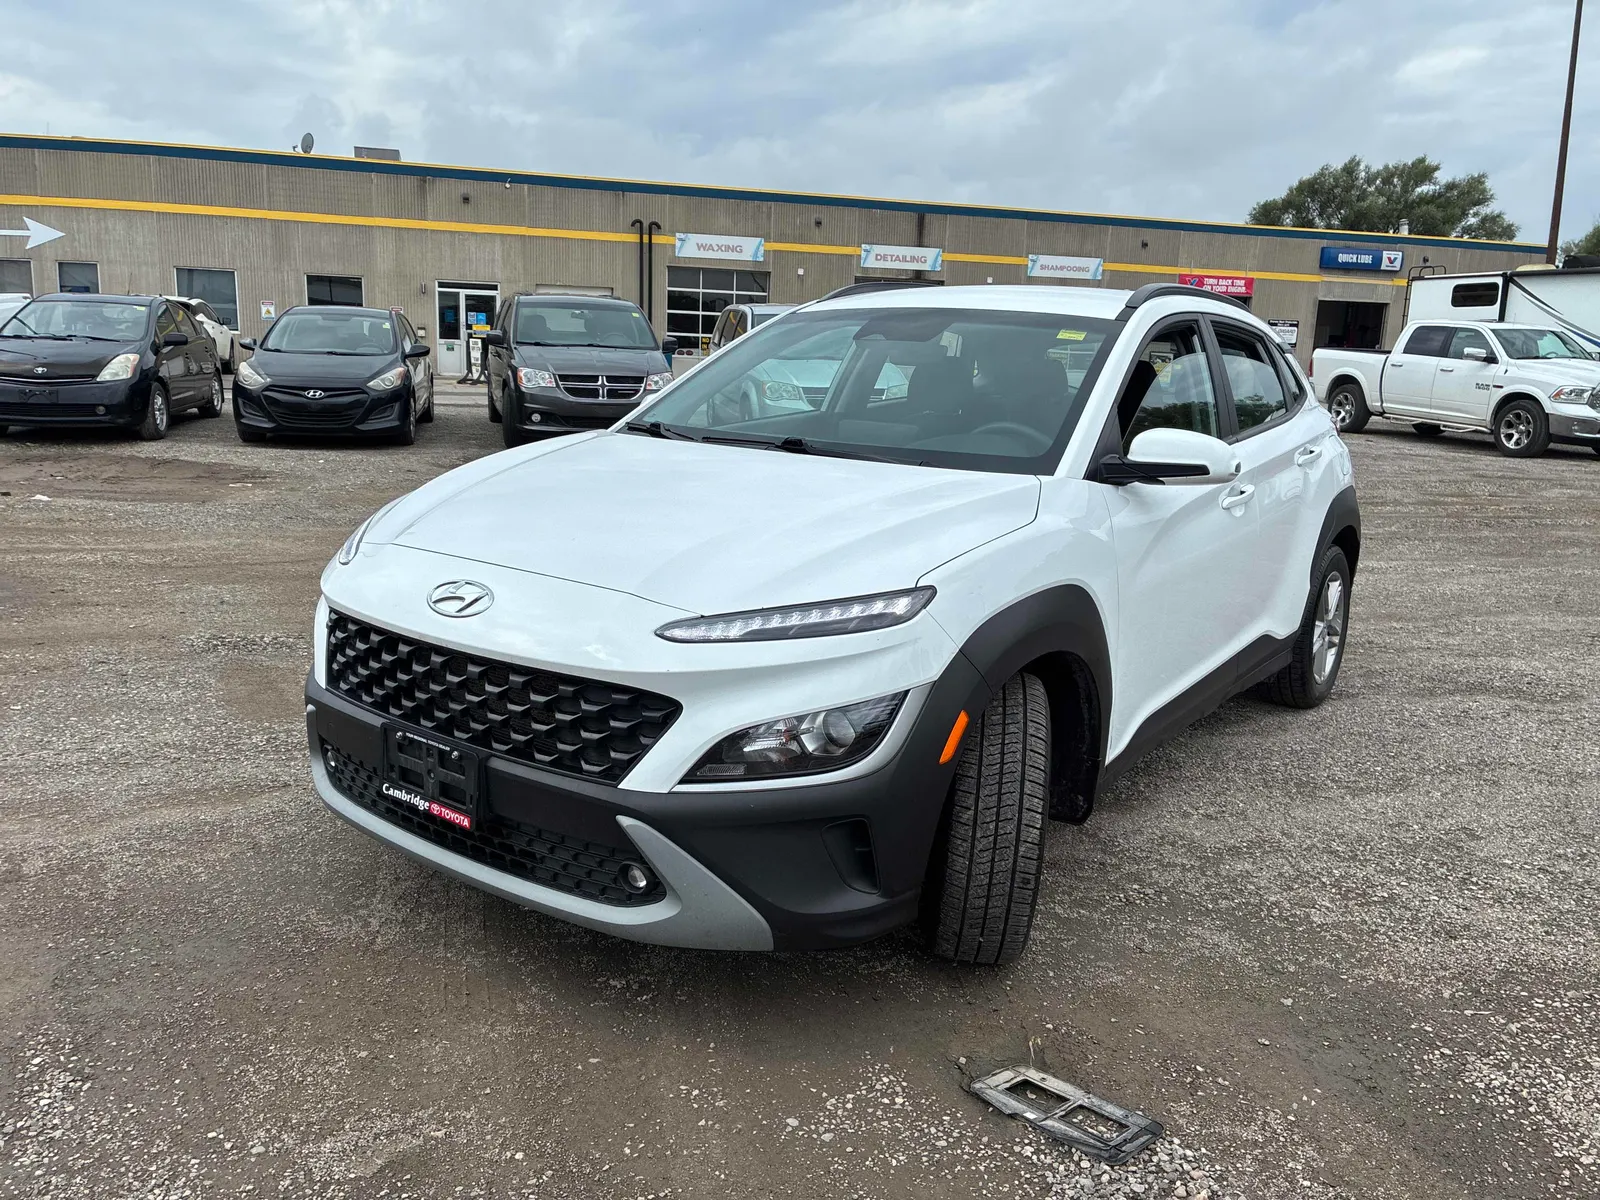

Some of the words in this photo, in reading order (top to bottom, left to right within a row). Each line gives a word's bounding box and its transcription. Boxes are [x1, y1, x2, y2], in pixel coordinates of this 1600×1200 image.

[696, 242, 743, 254] WAXING
[875, 253, 927, 264] DETAILING
[1338, 253, 1357, 264] QUICK
[1357, 254, 1373, 264] LUBE
[1040, 264, 1090, 273] SHAMPOOING
[1219, 278, 1232, 286] BACK
[428, 739, 438, 747] TOYOTA
[438, 743, 451, 751] DEALER
[382, 783, 430, 810] Cambridge
[440, 808, 469, 827] TOYOTA
